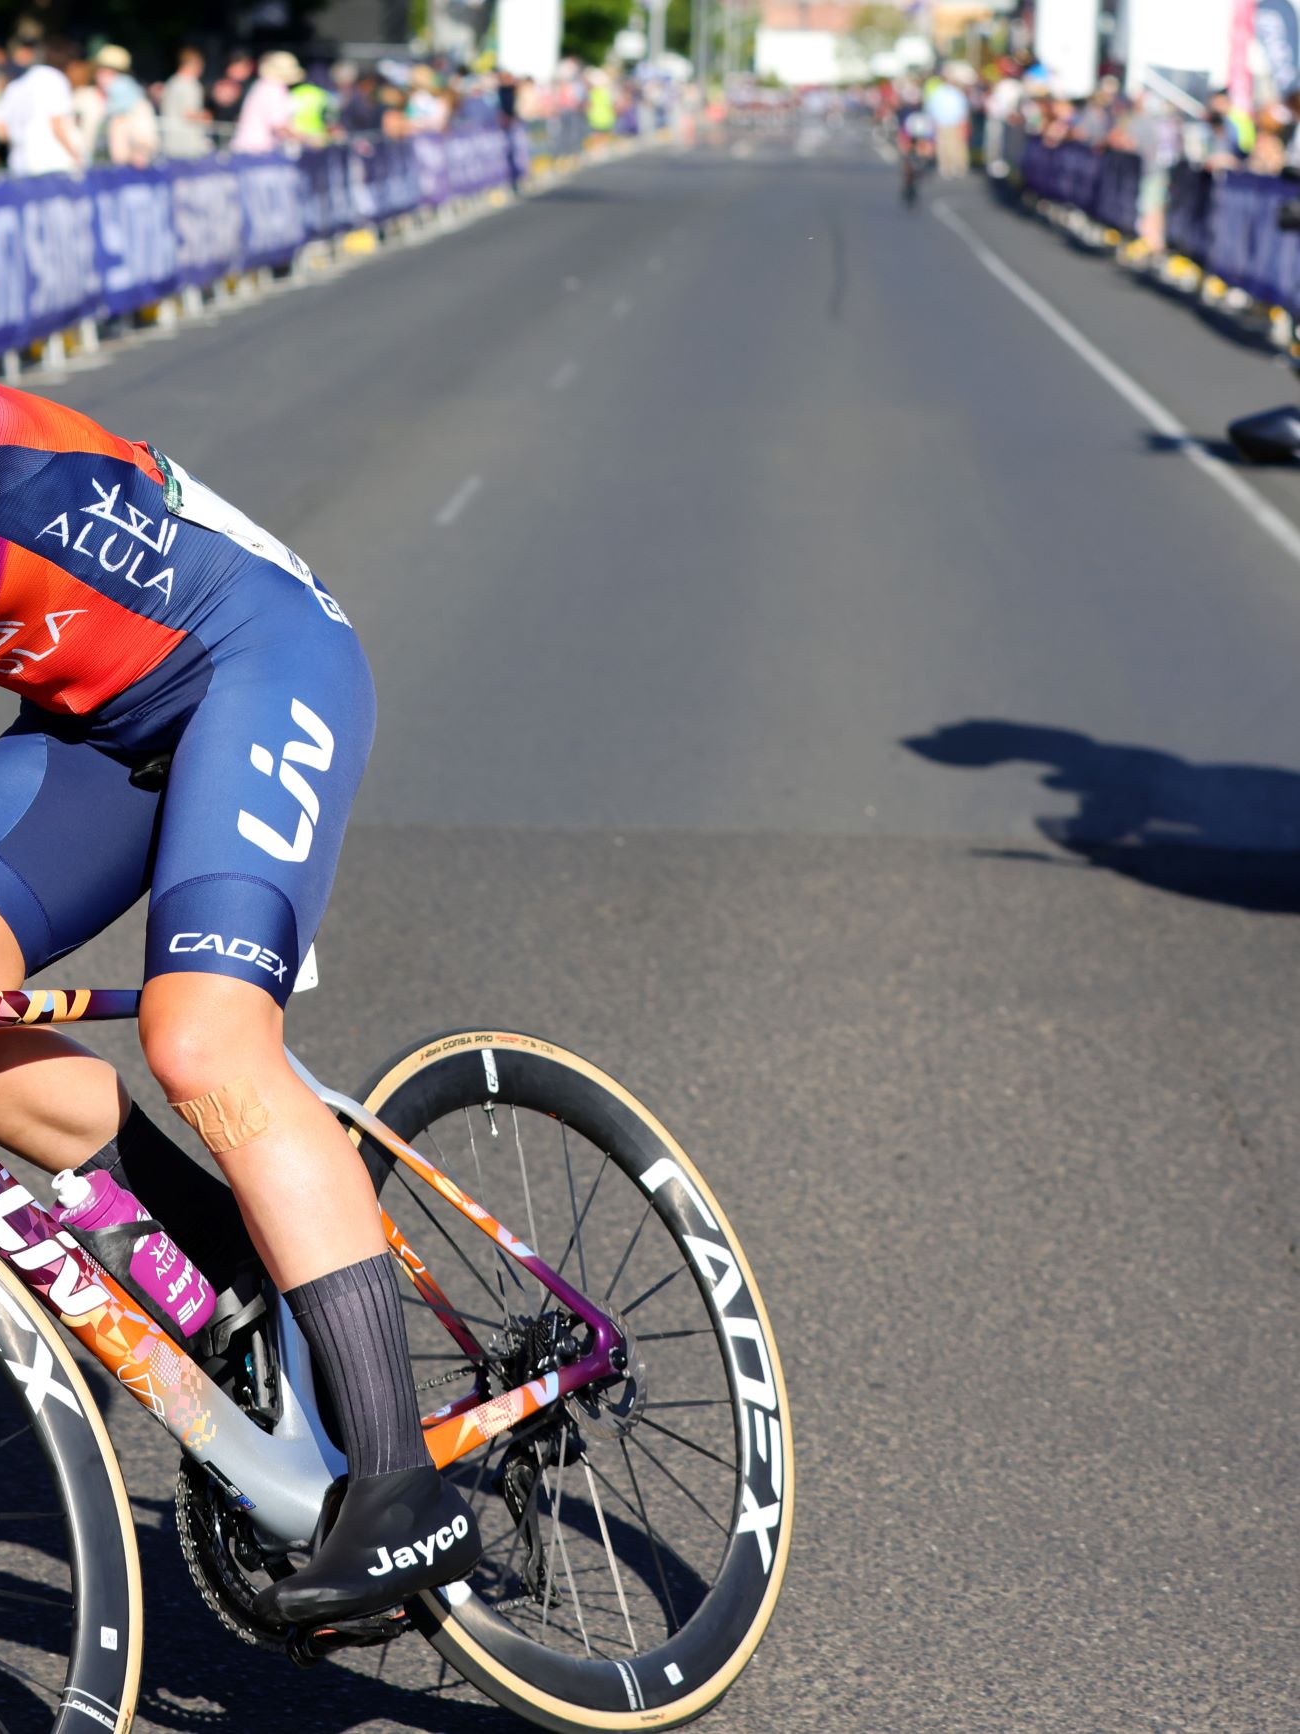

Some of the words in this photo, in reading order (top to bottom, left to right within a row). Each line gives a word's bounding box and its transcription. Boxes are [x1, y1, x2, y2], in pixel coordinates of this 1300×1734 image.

[35, 512, 174, 606] ALULA
[237, 697, 335, 863] Liv
[168, 932, 288, 984] CADEX
[639, 1157, 783, 1574] CADEX
[367, 1514, 469, 1577] Jayco
